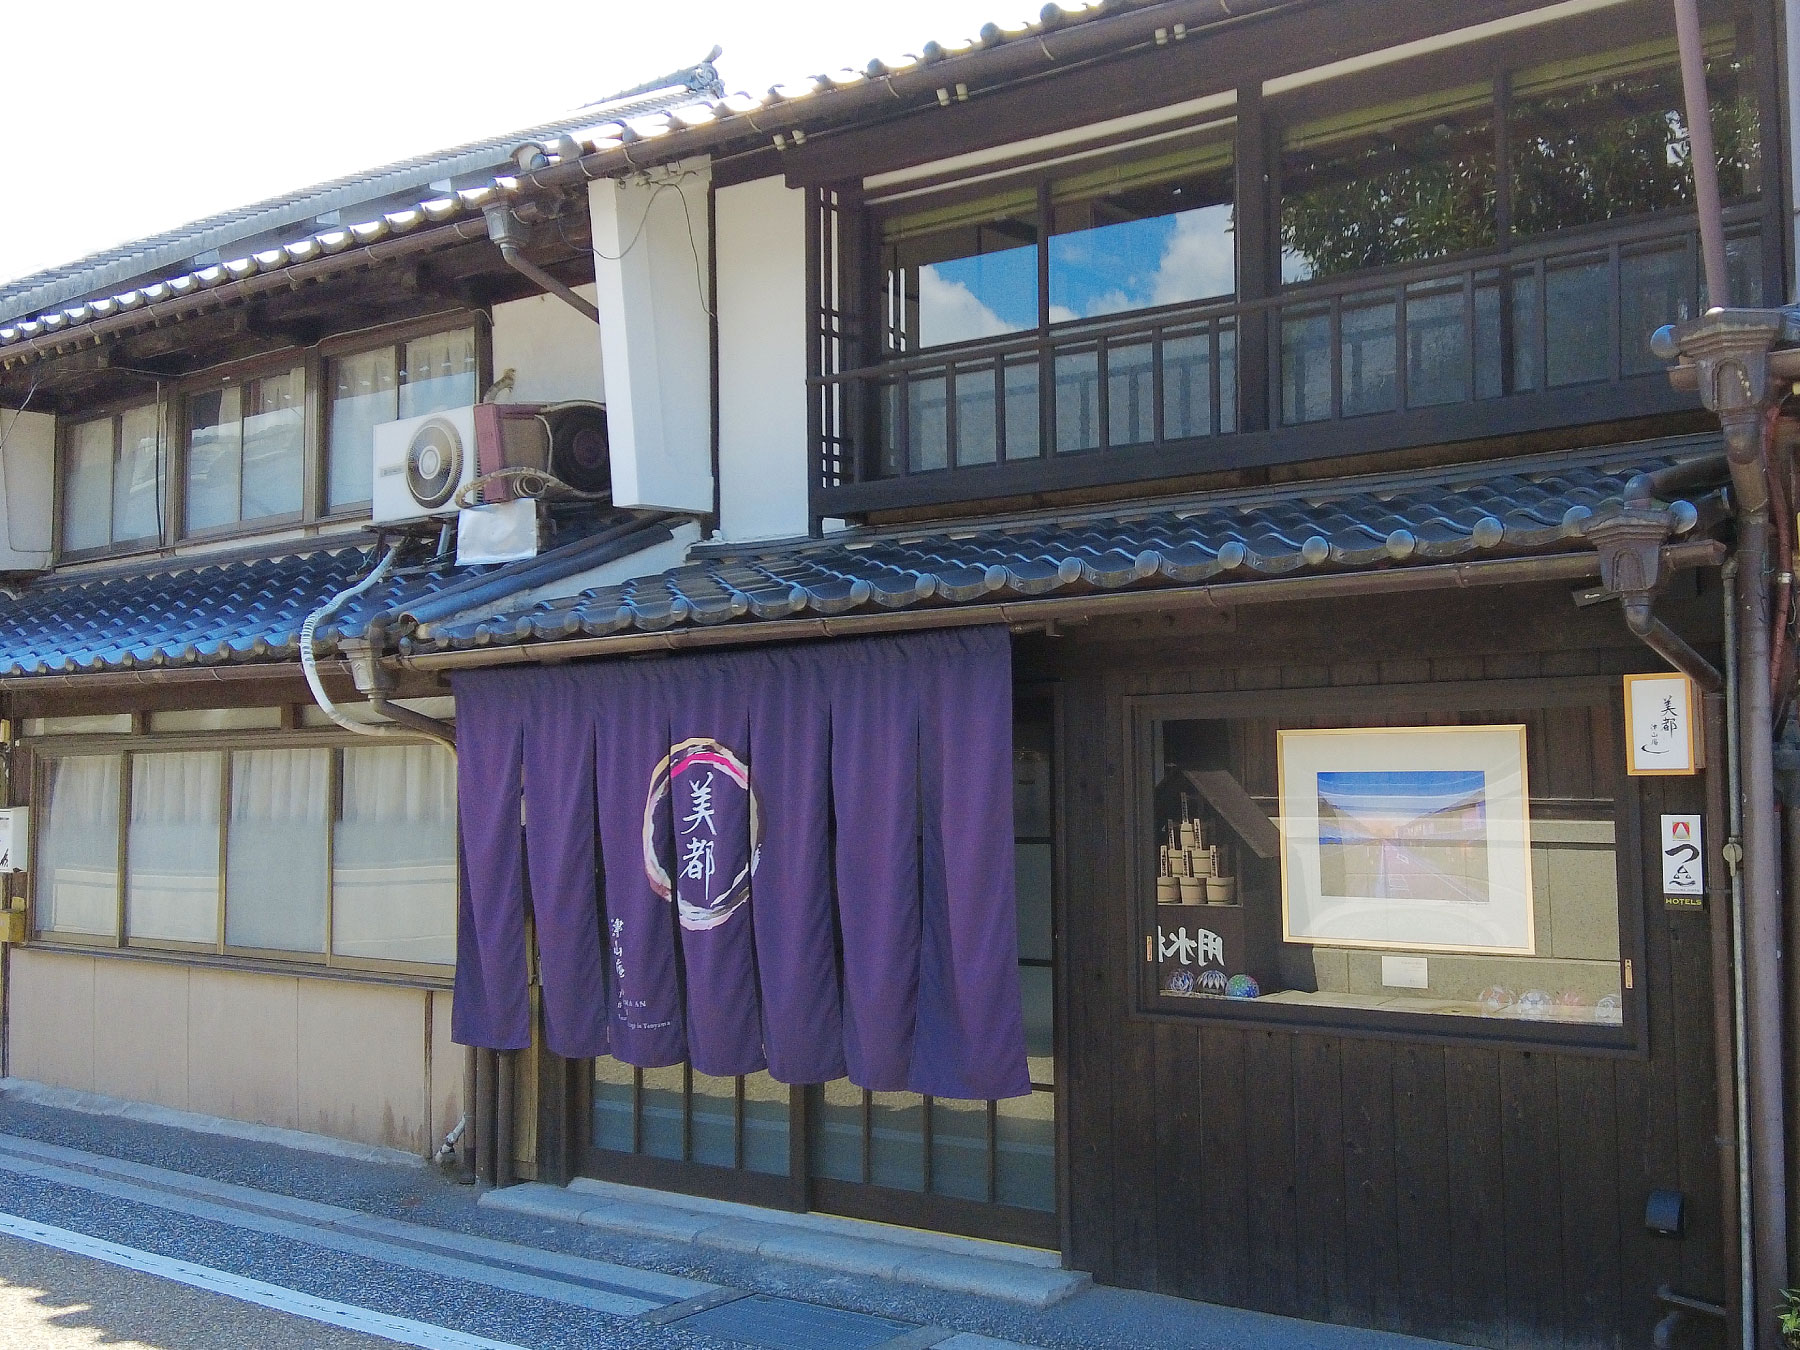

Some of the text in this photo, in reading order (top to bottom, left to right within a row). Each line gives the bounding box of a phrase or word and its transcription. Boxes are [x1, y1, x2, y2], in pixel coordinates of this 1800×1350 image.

[1661, 695, 1678, 738] 美都
[680, 771, 717, 900] 美都
[1665, 898, 1702, 906] HOTELS
